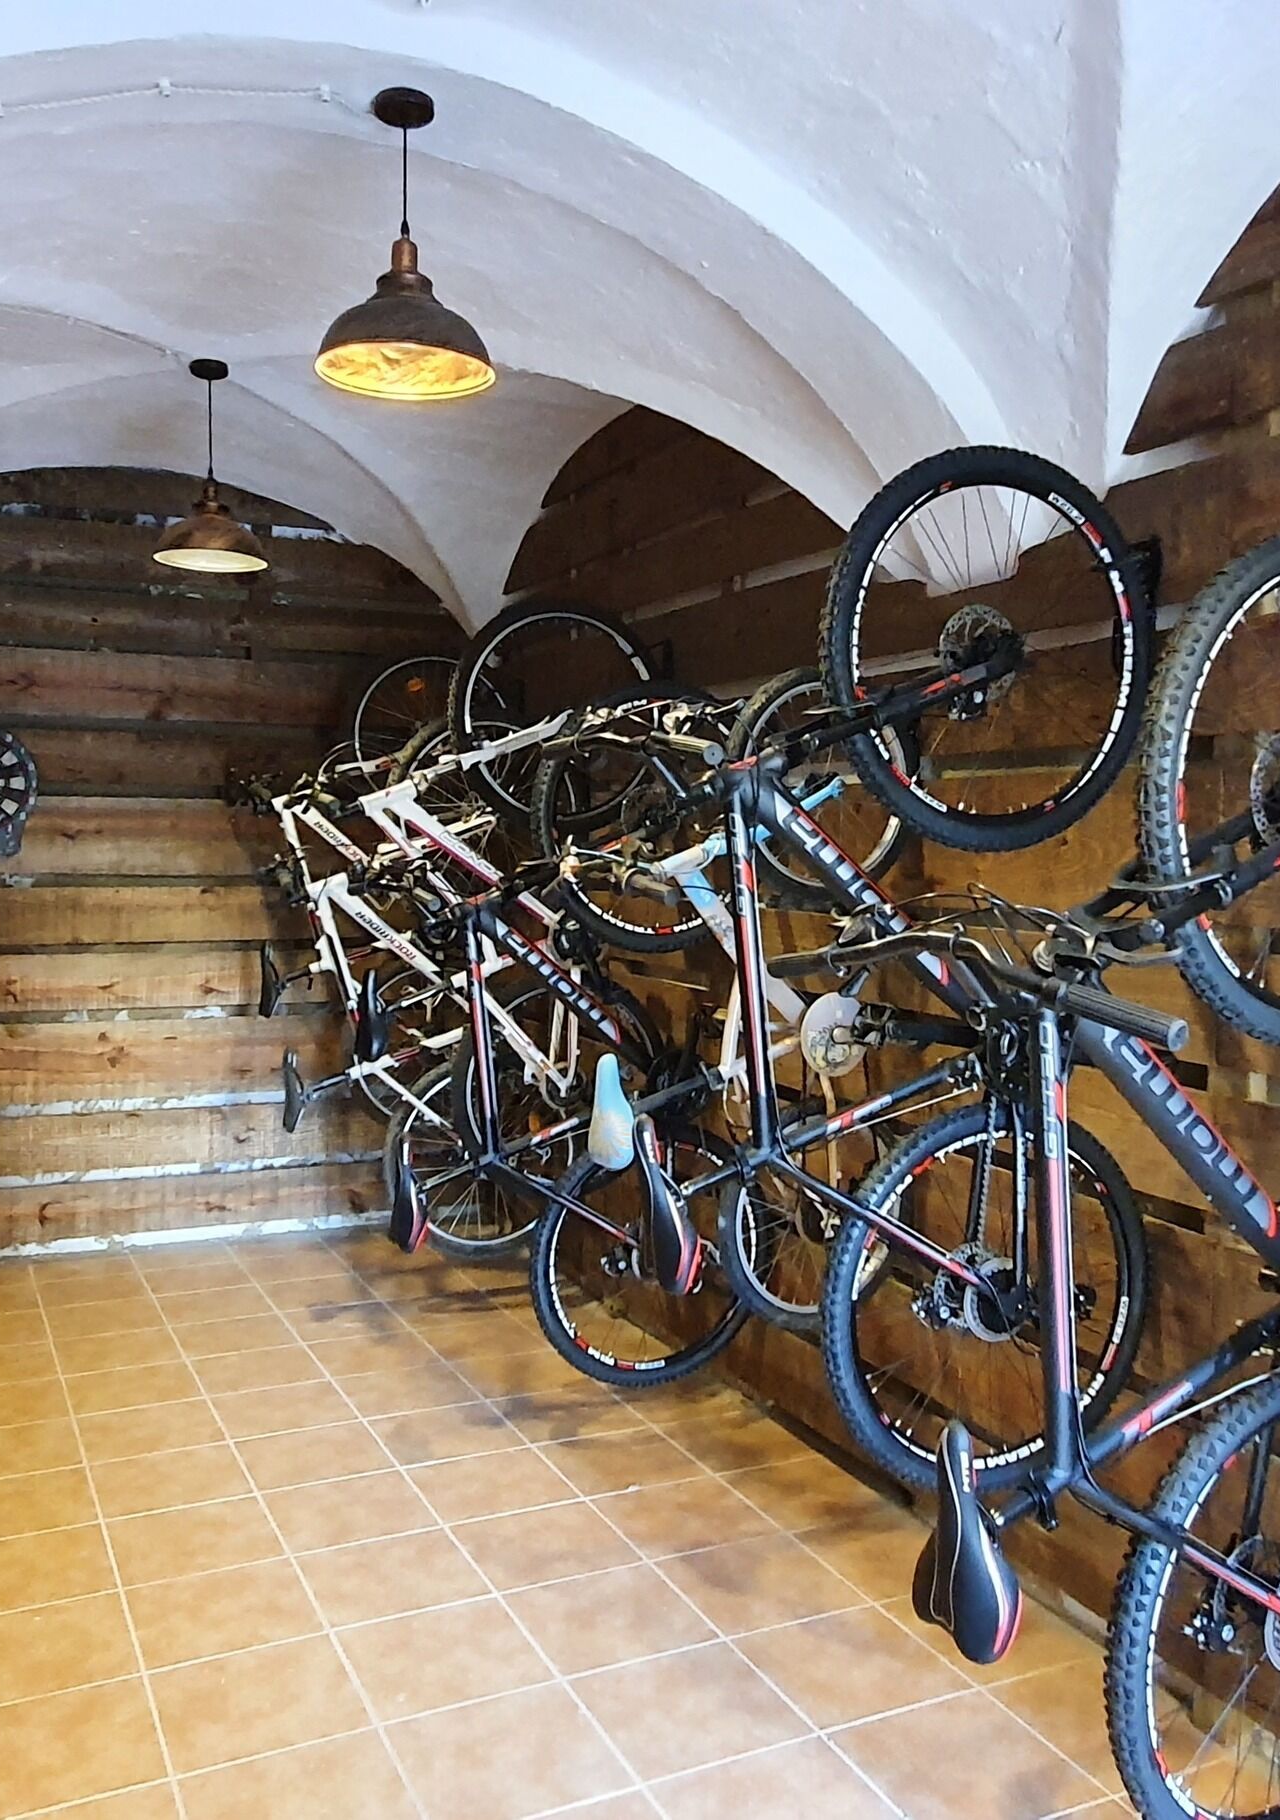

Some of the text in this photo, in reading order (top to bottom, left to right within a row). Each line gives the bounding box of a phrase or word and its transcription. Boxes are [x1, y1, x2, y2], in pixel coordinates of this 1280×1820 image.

[1099, 547, 1124, 593] RM
[354, 911, 416, 960] ROCKRIDER
[501, 928, 606, 1026] moma
[1104, 1035, 1261, 1205] moma
